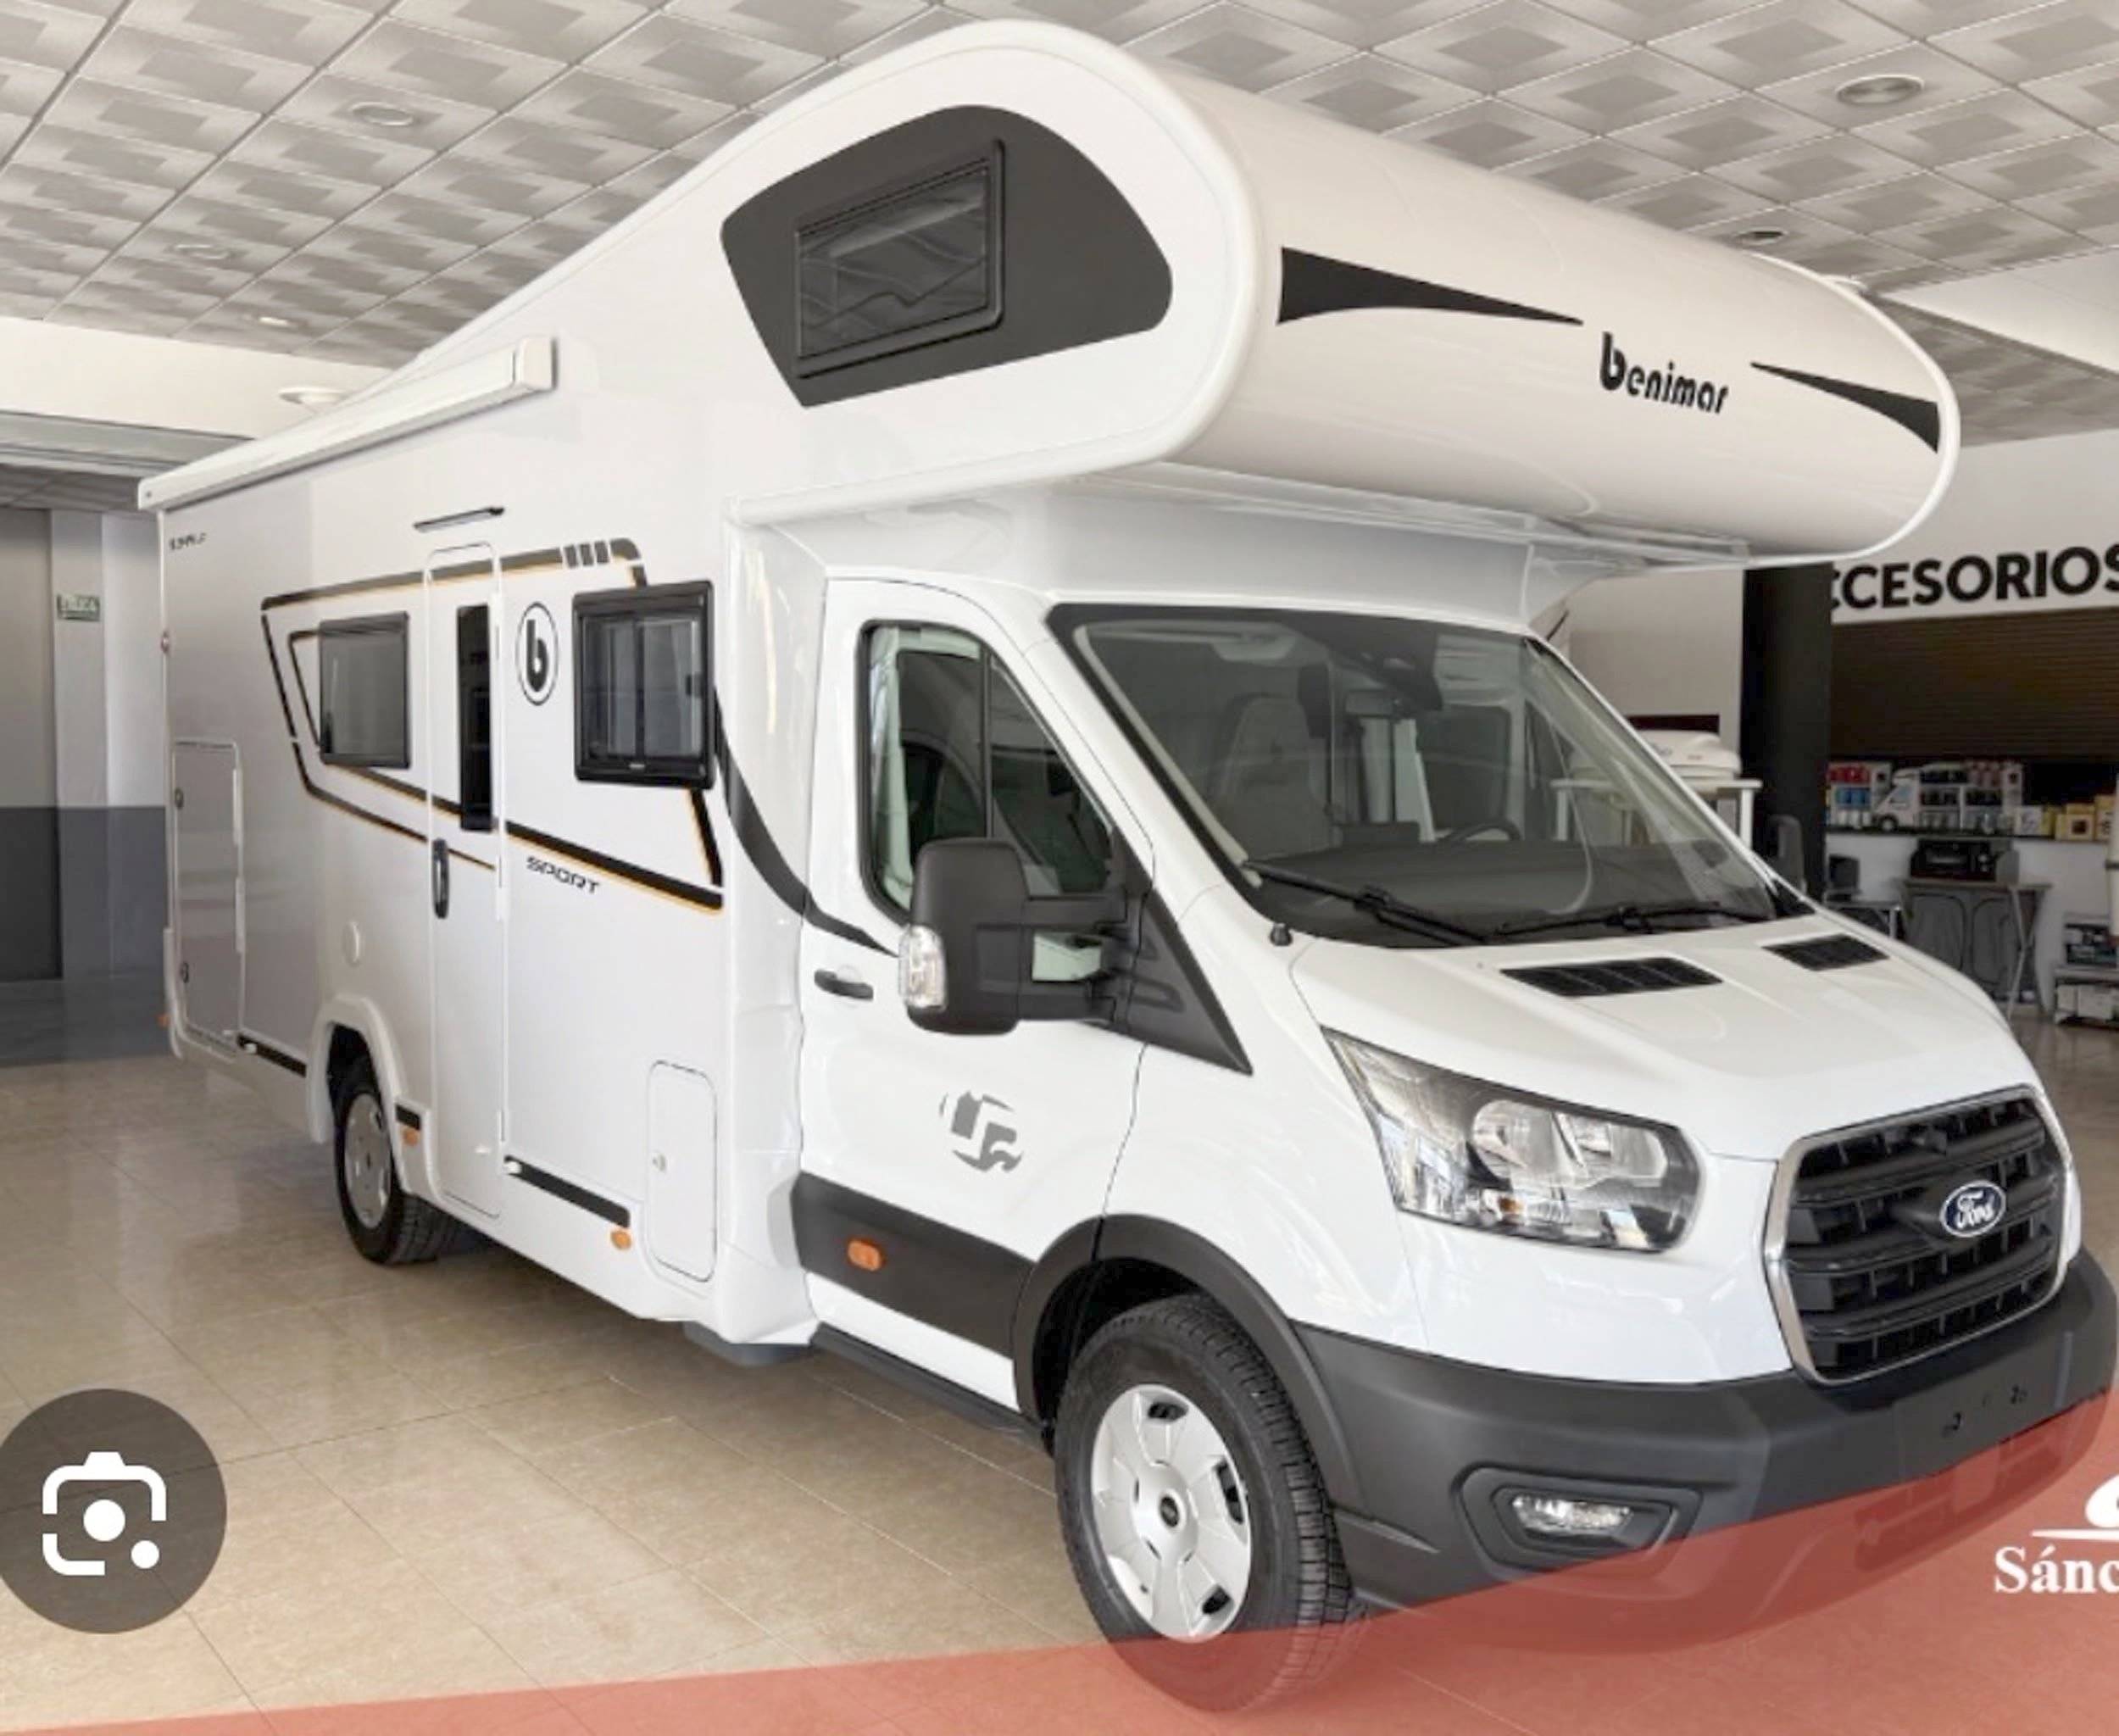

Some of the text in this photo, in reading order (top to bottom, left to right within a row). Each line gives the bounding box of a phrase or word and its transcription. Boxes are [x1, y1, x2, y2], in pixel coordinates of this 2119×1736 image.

[1600, 331, 1729, 414] benimar
[1831, 545, 2119, 609] CESORIO
[526, 855, 599, 894] SPORT
[1955, 1190, 1995, 1229] Ford
